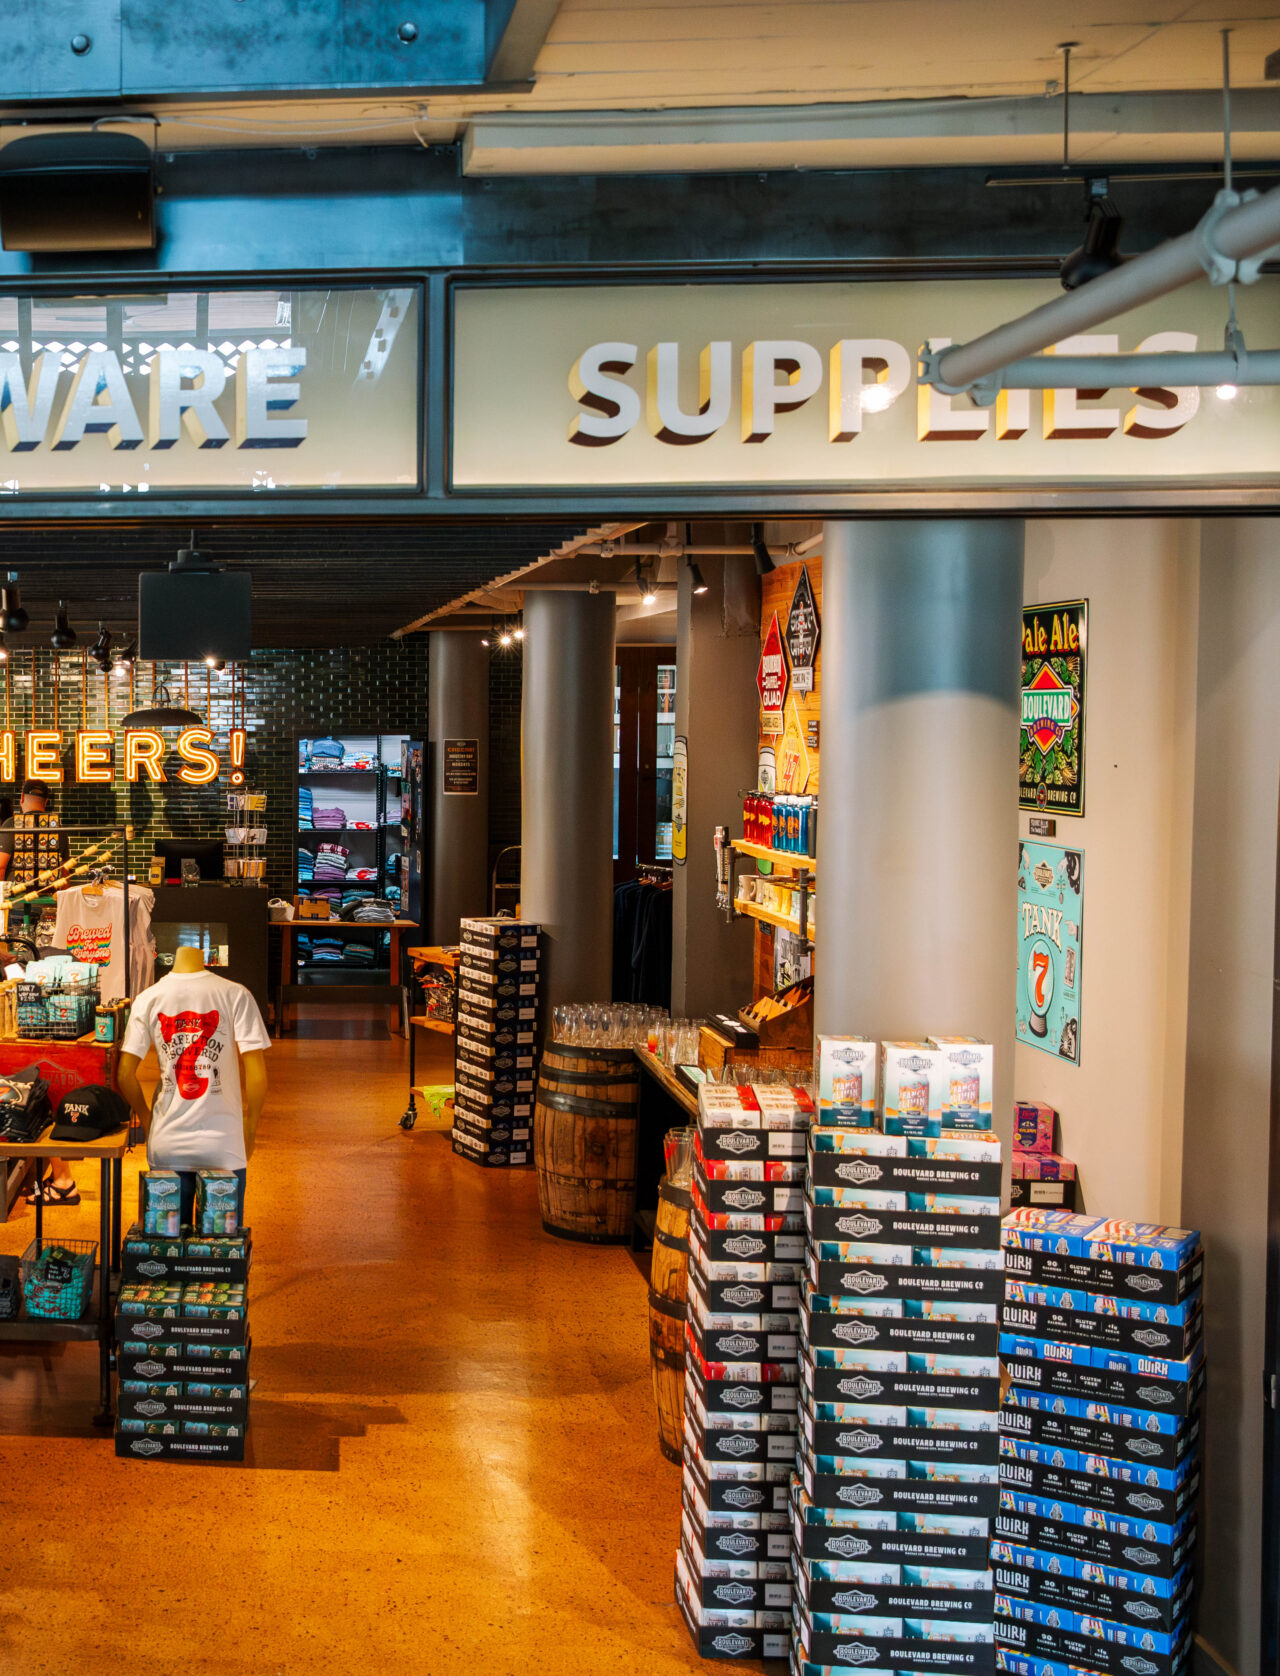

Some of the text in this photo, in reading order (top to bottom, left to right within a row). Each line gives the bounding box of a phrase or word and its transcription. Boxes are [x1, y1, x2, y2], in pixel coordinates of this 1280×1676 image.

[1050, 612, 1079, 653] Ale
[1023, 694, 1070, 720] BOULEVARD
[1030, 717, 1055, 737] BREWING
[68, 922, 112, 941] Brewed
[1022, 902, 1063, 952] TANK
[84, 940, 98, 950] For
[1033, 950, 1049, 1008] 7
[98, 1025, 106, 1034] 7
[64, 1103, 89, 1116] TANK
[70, 1112, 80, 1122] 7
[723, 1137, 753, 1146] BOULEVARD
[840, 1166, 877, 1177] BOULEVARD
[893, 1168, 934, 1178] BOULEVARD
[936, 1170, 969, 1180] BREWING
[728, 1193, 758, 1202] BOULEVARD
[840, 1220, 877, 1231] BOULEVARD
[893, 1222, 969, 1234] BOULEVARD BREWING
[729, 1241, 759, 1250] BOULEVARD
[1006, 1254, 1032, 1270] UiRK
[846, 1274, 882, 1286] BOULEVARD
[898, 1277, 974, 1289] BOULEVARD BREWING
[727, 1290, 757, 1299] BOULEVARD
[836, 1326, 873, 1337] BOULEVARD
[889, 1328, 965, 1340] BOULEVARD BREWING
[722, 1339, 752, 1348] BOULEVARD
[1044, 1344, 1072, 1360] QUiRK
[1138, 1359, 1168, 1374] QUiRK
[842, 1380, 878, 1392] BOULEVARD
[894, 1383, 970, 1395] BOULEVARD BREWING
[726, 1391, 756, 1400] BOULEVARD
[722, 1440, 752, 1449] BOULEVARD
[840, 1434, 877, 1446] BOULEVARD
[893, 1437, 969, 1449] BOULEVARD BREWING
[728, 1492, 758, 1501] BOULEVARD
[840, 1488, 877, 1500] BOULEVARD
[893, 1491, 969, 1503] BOULEVARD BREWING
[722, 1538, 752, 1547] BOULEVARD
[828, 1540, 865, 1551] BOULEVARD
[881, 1542, 957, 1554] BOULEVARD BREWING
[720, 1587, 750, 1596] BOULEVARD
[836, 1594, 872, 1605] BOULEVARD
[888, 1596, 964, 1608] BOULEVARD BREWING
[718, 1638, 748, 1647] BOULEVARD
[836, 1646, 873, 1658] BOULEVARD
[889, 1649, 965, 1661] BOULEVARD BREWING
